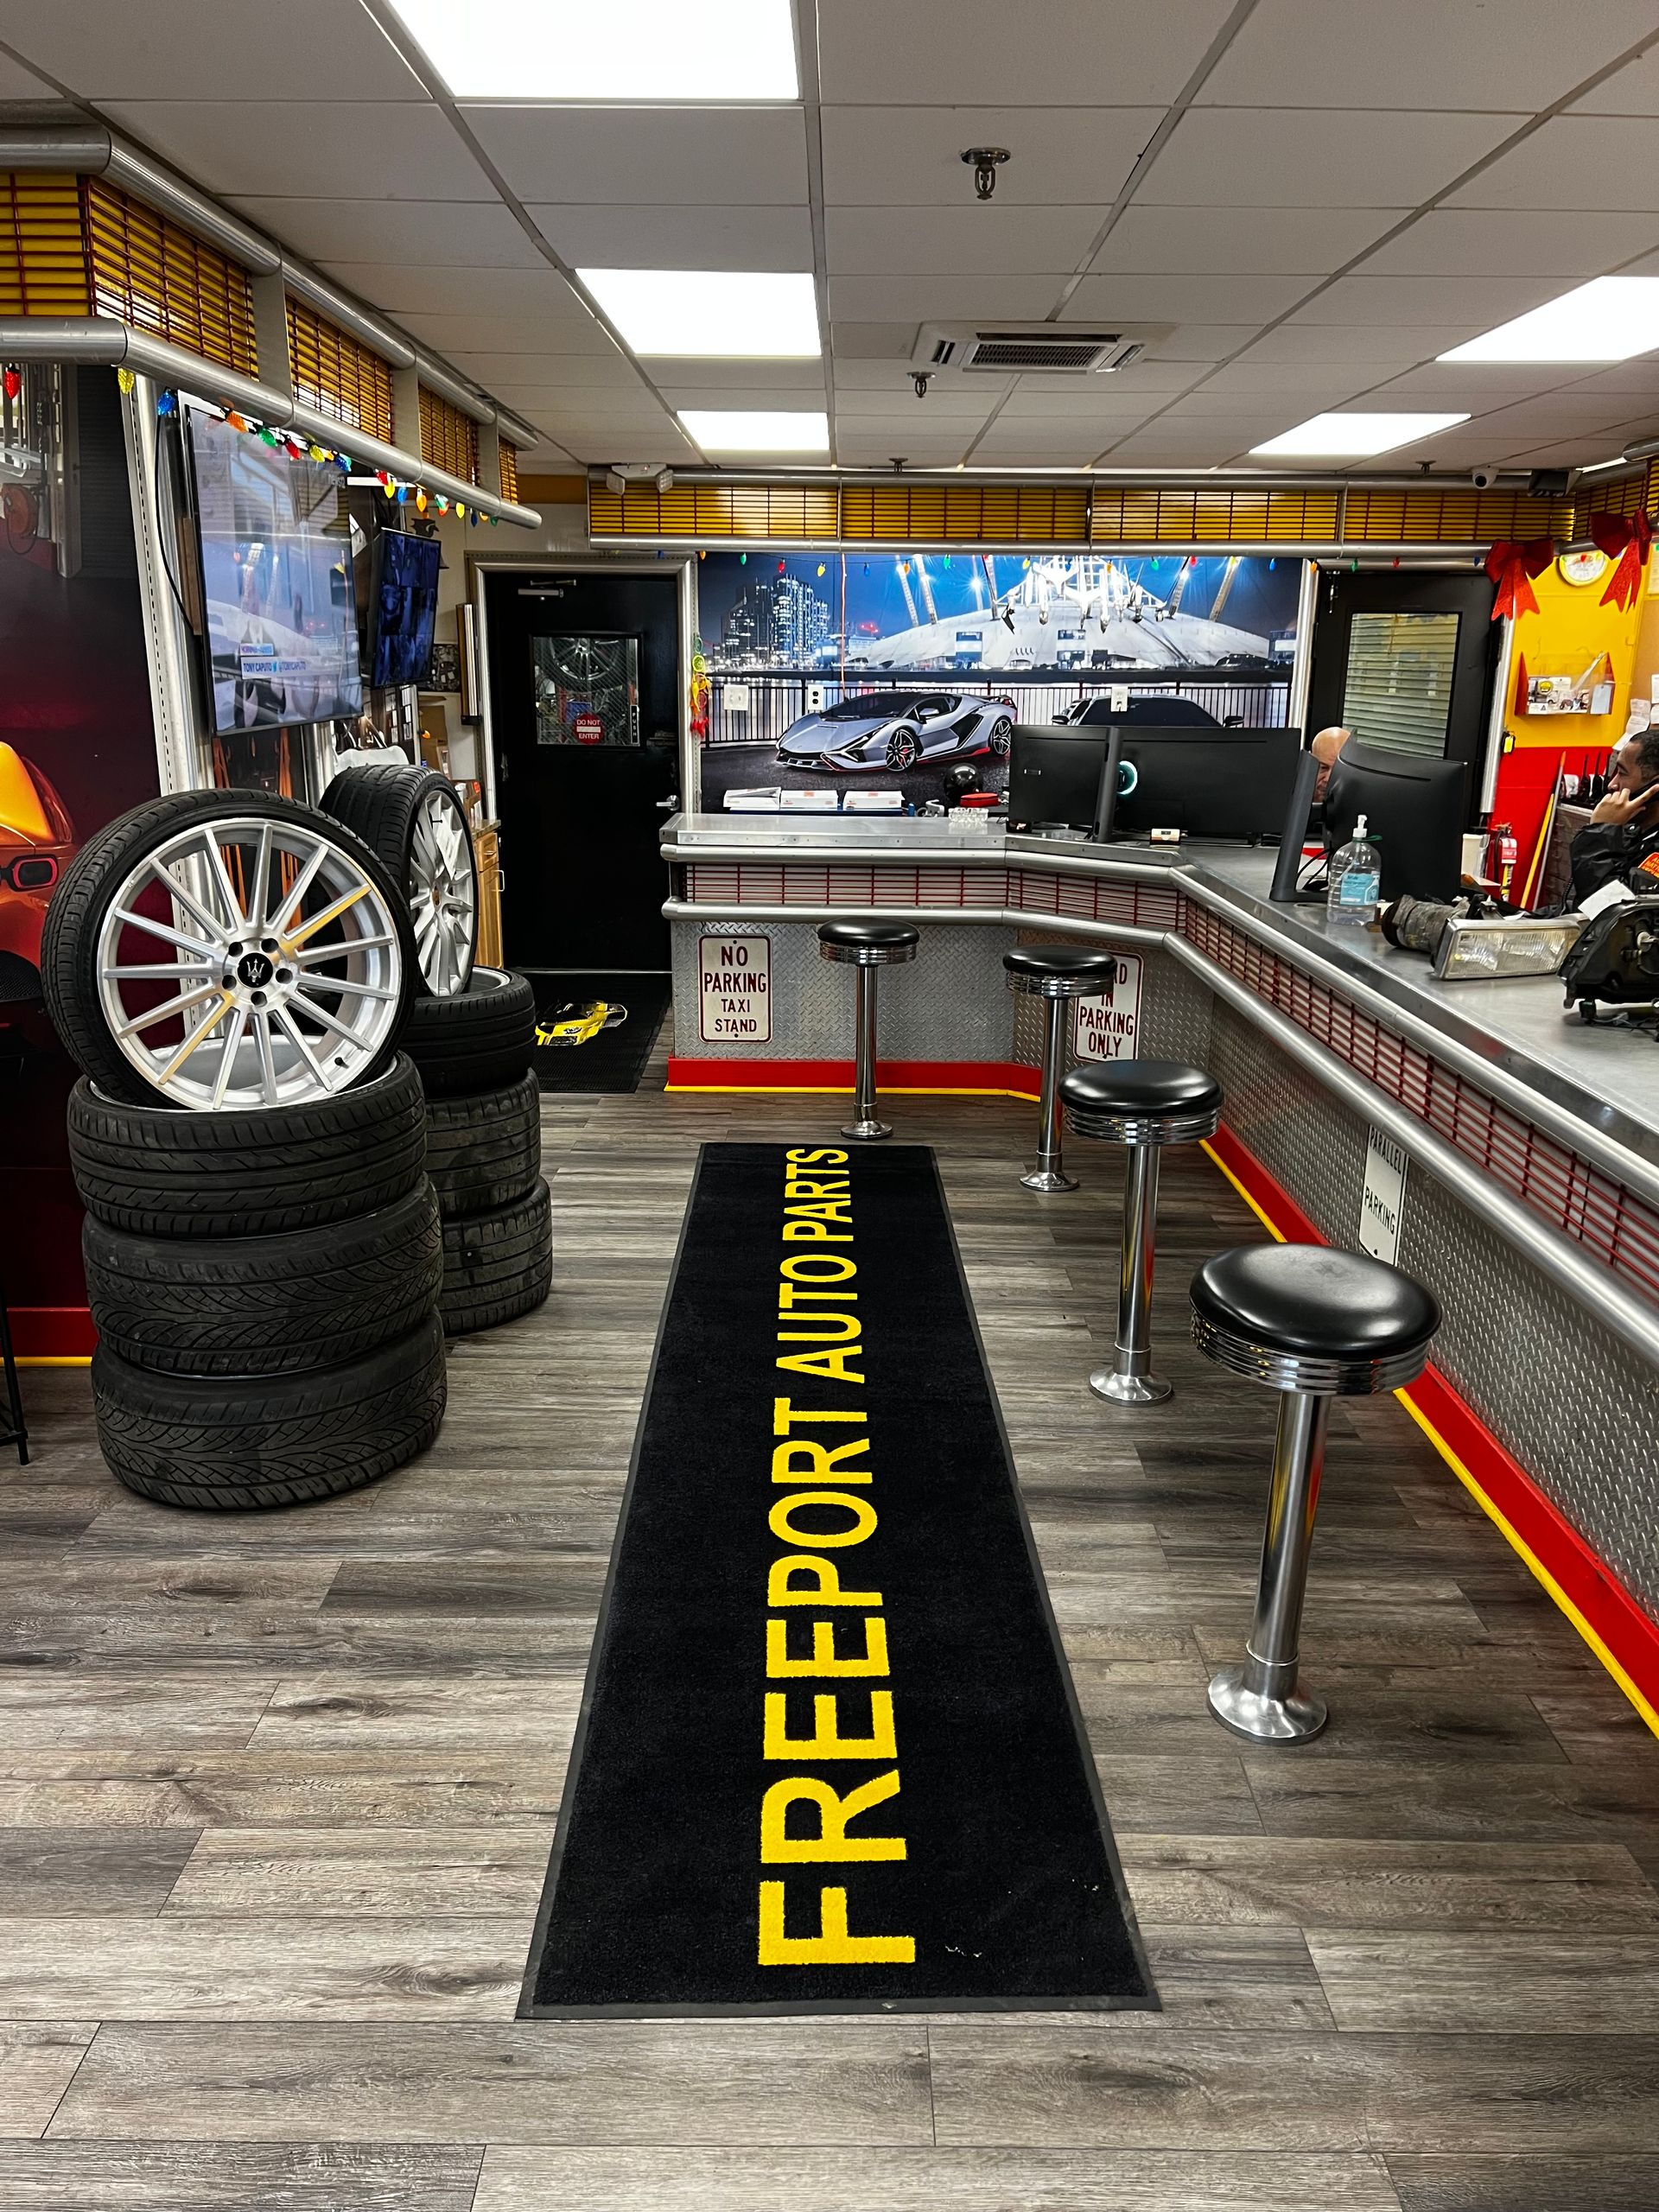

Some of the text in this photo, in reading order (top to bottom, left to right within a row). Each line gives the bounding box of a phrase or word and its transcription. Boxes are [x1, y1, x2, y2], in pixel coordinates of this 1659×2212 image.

[244, 663, 255, 672] TONY
[256, 662, 272, 671] CAPUTO
[721, 946, 748, 967] NO
[703, 972, 766, 993] PARKING
[721, 998, 751, 1014] TAXI
[715, 1018, 757, 1033] STAND
[1079, 1006, 1135, 1036] PARKING
[1088, 1031, 1122, 1058] ONLY
[1370, 1128, 1402, 1176] PARALLEL
[1364, 1186, 1396, 1236] PARKING
[758, 1148, 916, 1967] FREEPORT AUTO PARTS
